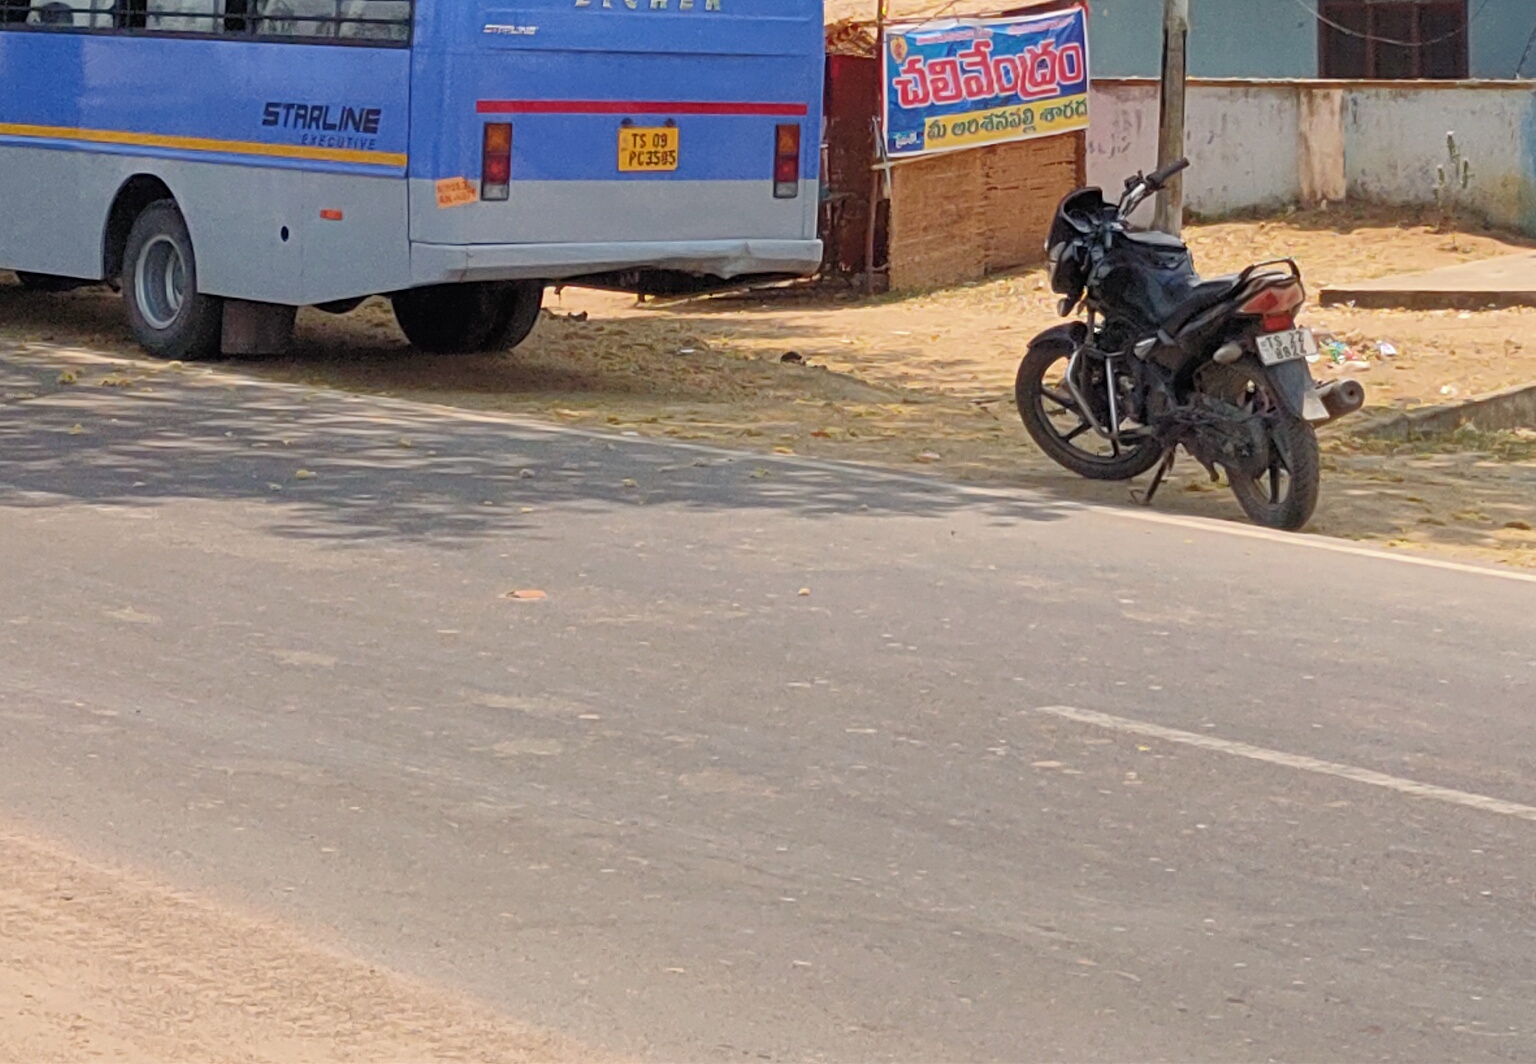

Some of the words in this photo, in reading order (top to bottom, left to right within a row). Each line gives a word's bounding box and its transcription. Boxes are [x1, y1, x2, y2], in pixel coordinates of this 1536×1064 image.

[894, 39, 1084, 109] చలివేంద్రం
[262, 102, 382, 134] STARLINE
[301, 133, 376, 151] EXECUTIVE
[632, 133, 646, 148] TS
[653, 133, 668, 148] 09
[1265, 335, 1283, 349] TS
